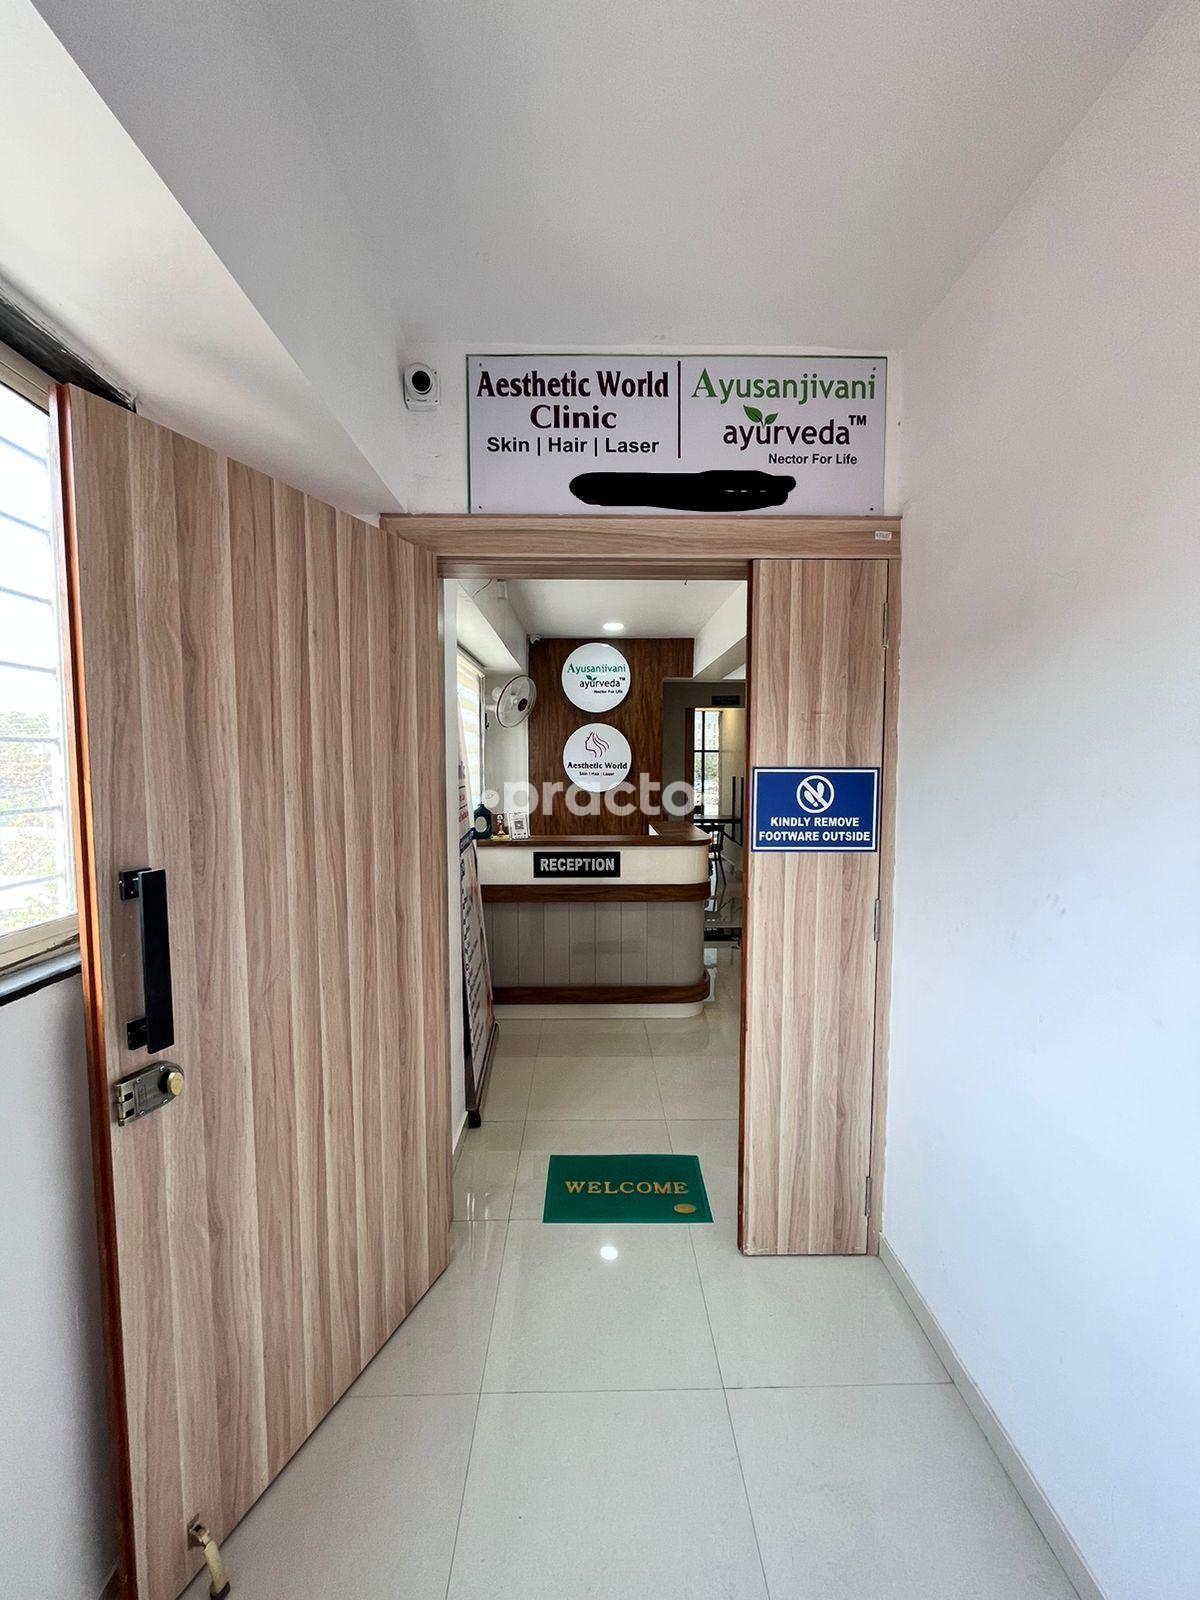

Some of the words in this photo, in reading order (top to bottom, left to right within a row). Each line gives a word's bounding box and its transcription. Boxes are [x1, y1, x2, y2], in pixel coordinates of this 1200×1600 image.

[476, 370, 591, 397] Aesthetic
[596, 371, 669, 398] World
[691, 367, 876, 405] Ayusanjivani
[530, 404, 617, 429] Clinic
[487, 437, 530, 453] Skin
[548, 437, 588, 453] Hair
[605, 437, 660, 453] Laser
[768, 453, 809, 465] Nector
[812, 453, 833, 465] For
[836, 453, 858, 465] Life
[604, 762, 628, 770] World
[770, 817, 812, 827] KINDLY
[813, 817, 860, 827] REMOVE
[759, 831, 819, 841] FOOTWARE
[822, 831, 871, 841] OUTSIDE
[540, 858, 615, 872] RECEPTION
[564, 1180, 689, 1195] WELCOME
